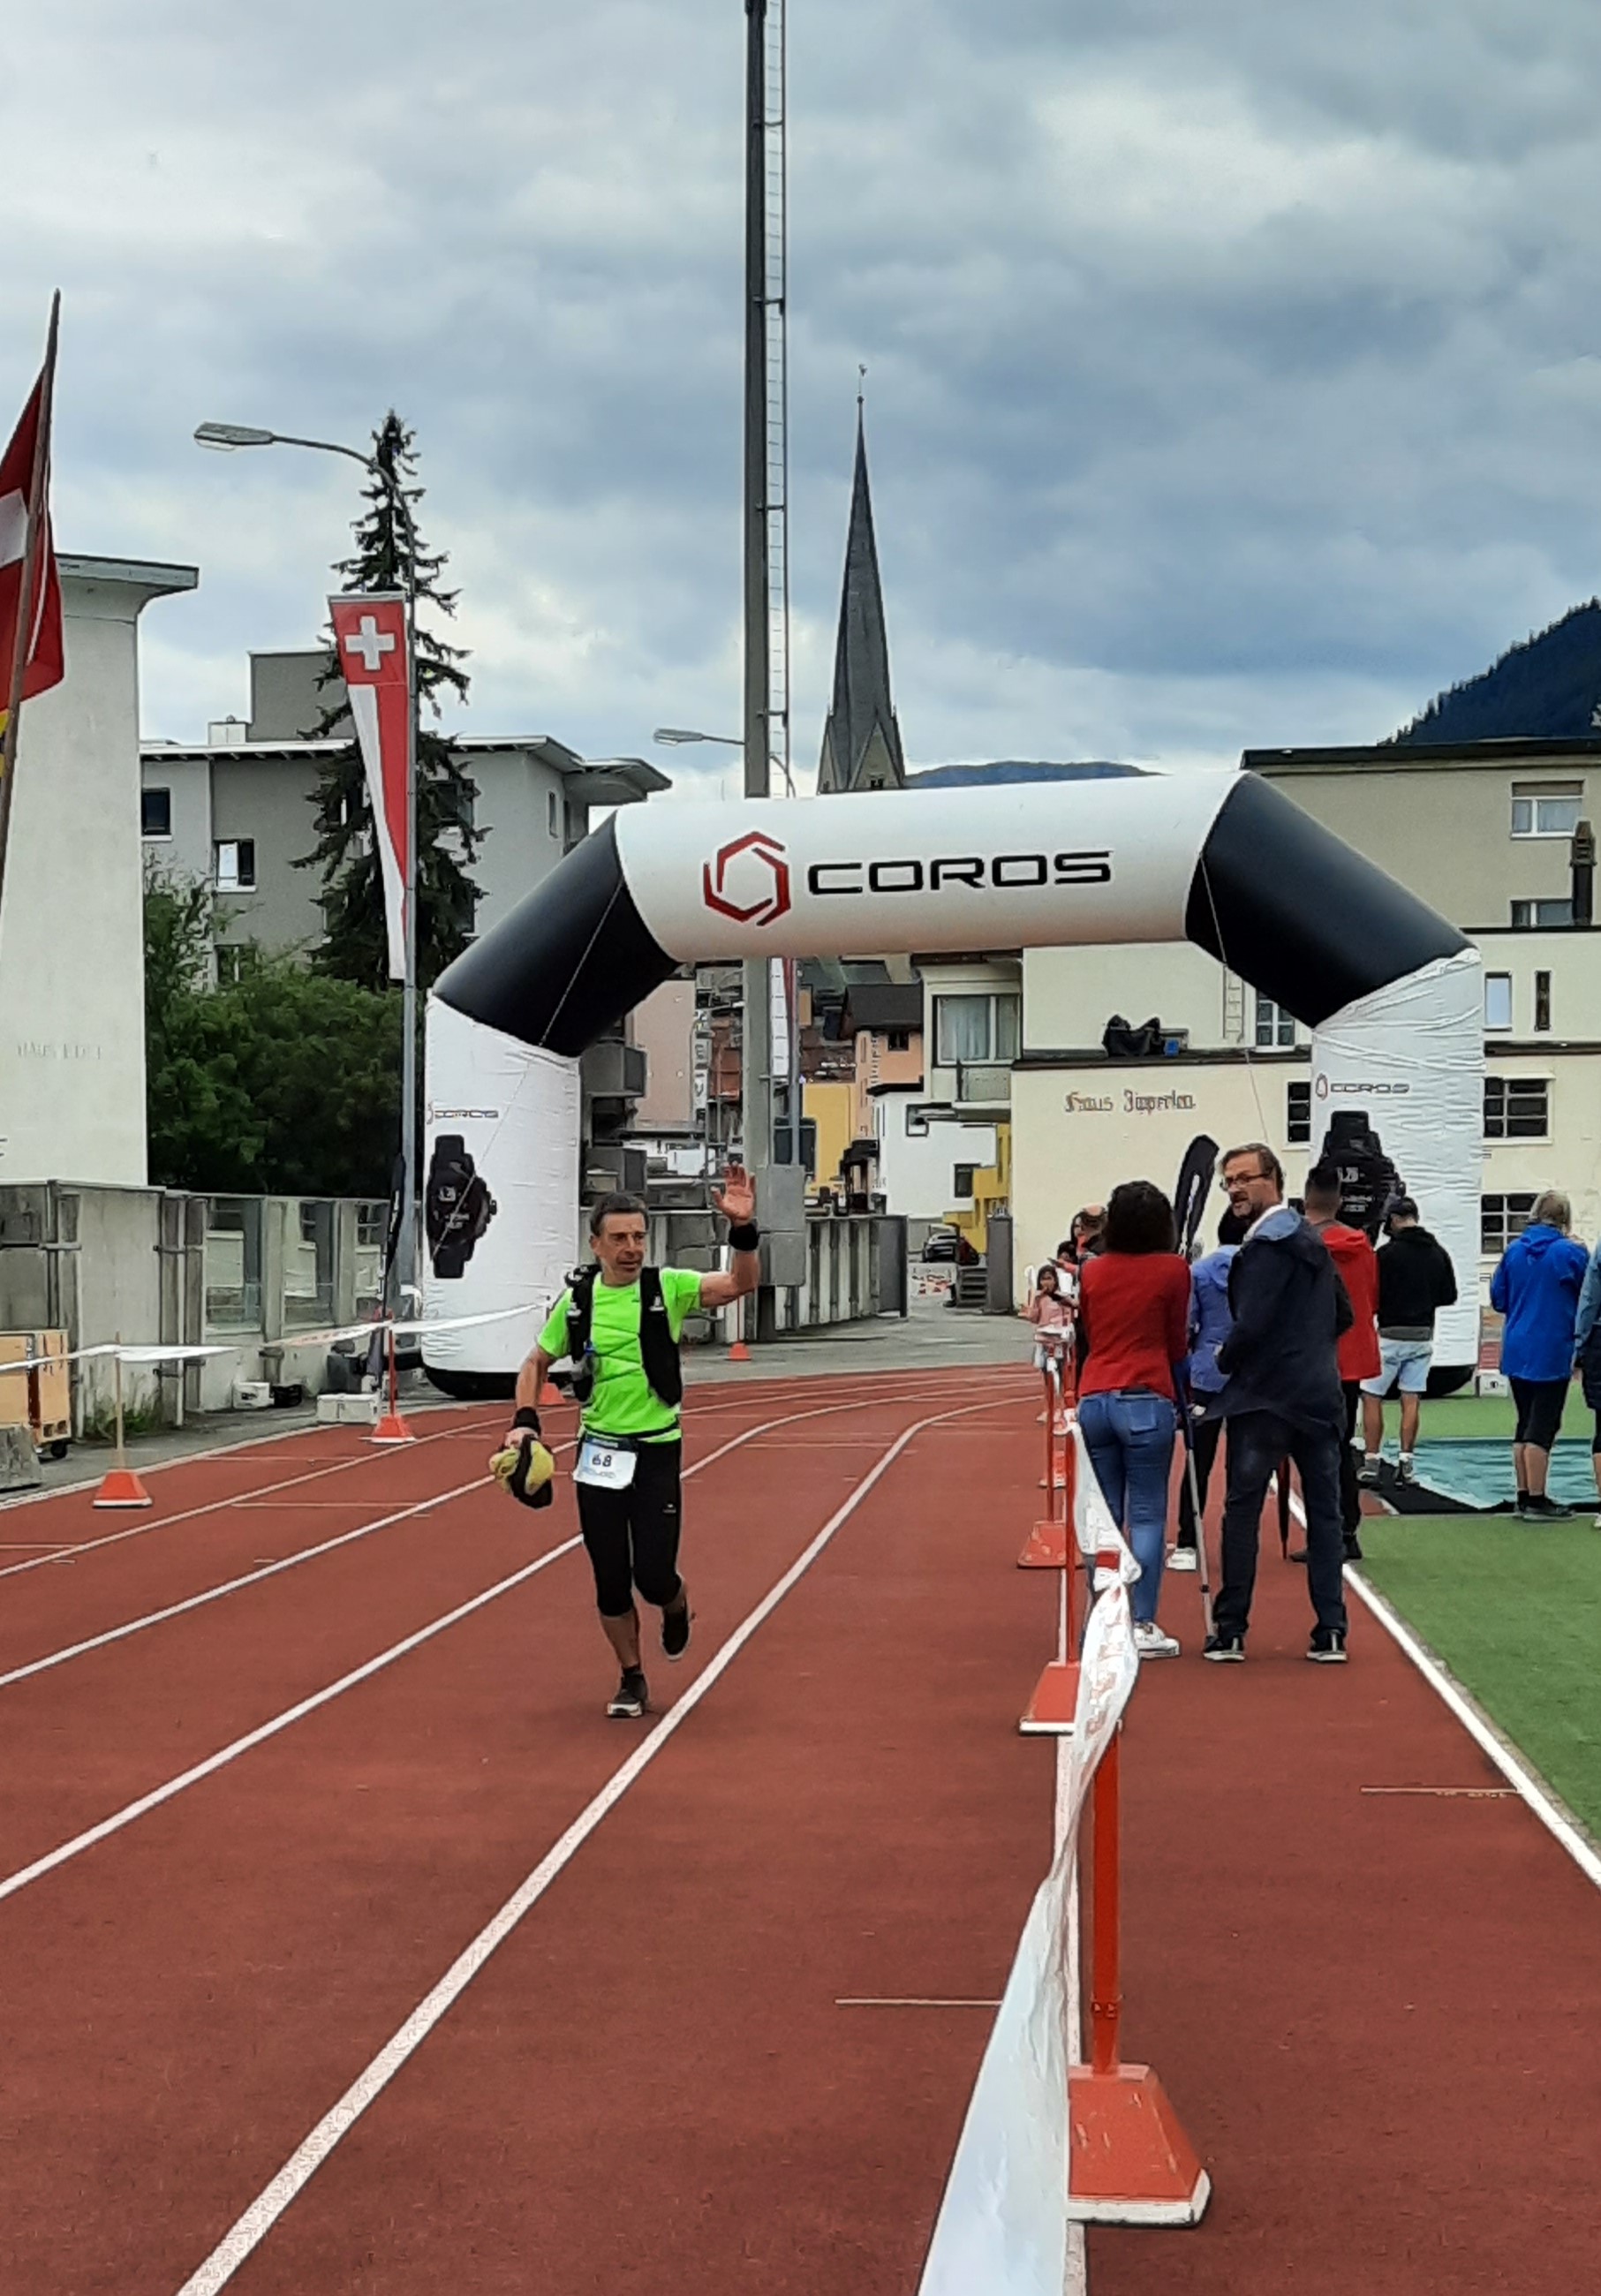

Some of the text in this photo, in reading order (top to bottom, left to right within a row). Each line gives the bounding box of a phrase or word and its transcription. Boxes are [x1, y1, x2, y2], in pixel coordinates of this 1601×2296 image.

[808, 850, 1112, 895] COROS
[1330, 1083, 1409, 1093] COROS
[592, 1454, 612, 1468] 68
